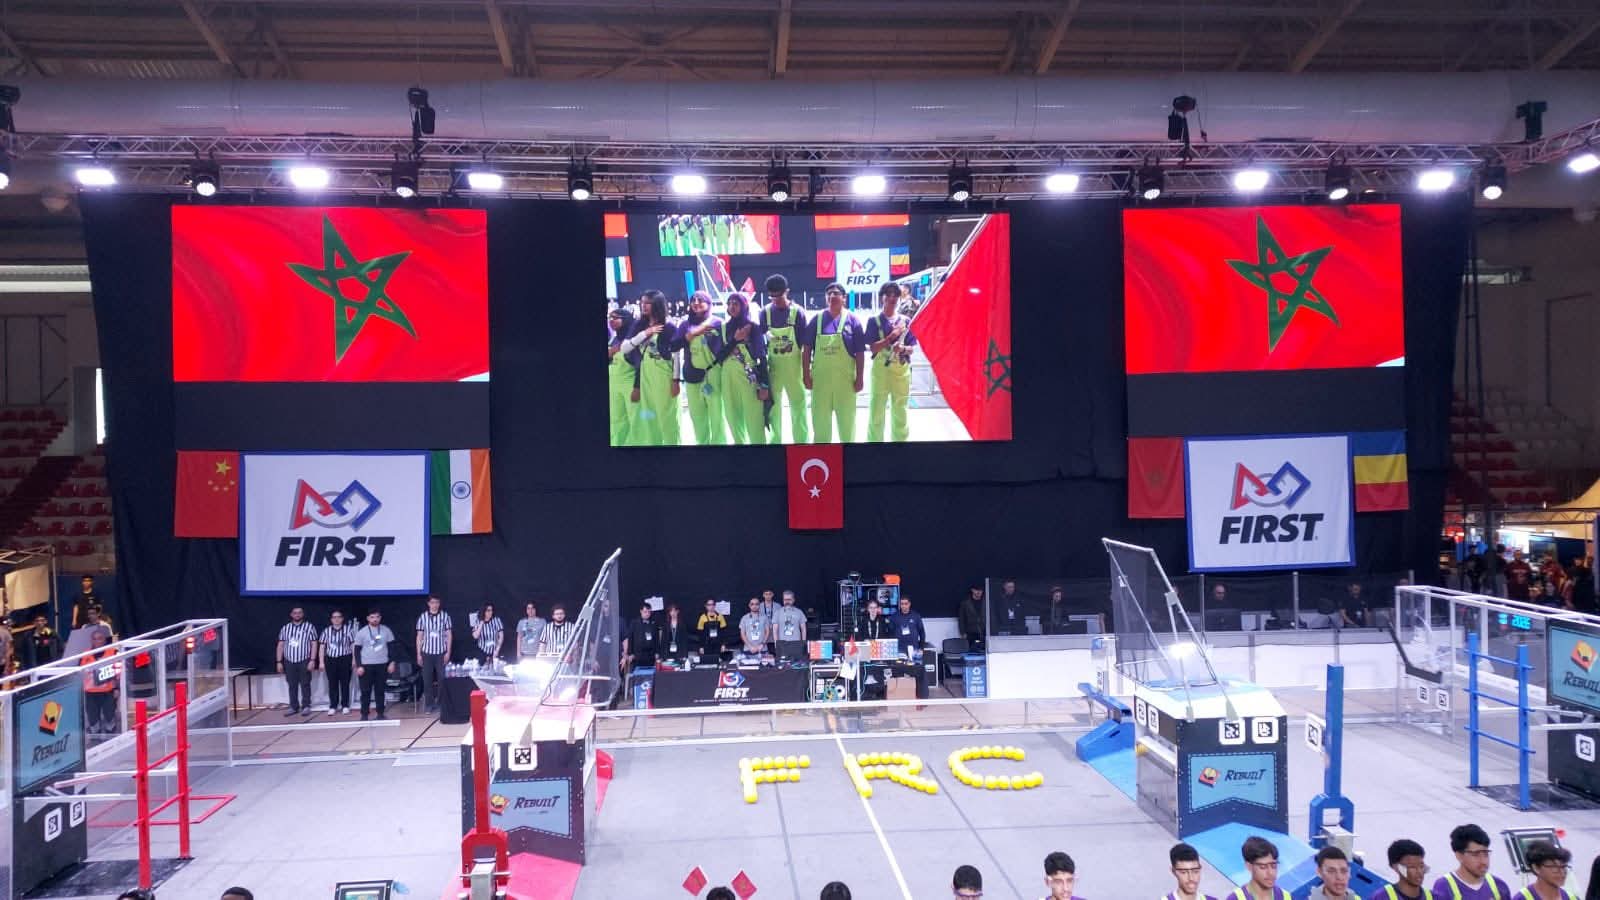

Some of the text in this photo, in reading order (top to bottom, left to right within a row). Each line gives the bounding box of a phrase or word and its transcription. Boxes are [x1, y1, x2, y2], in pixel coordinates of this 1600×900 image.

[846, 275, 880, 285] FIRST
[1219, 513, 1324, 545] FIRST
[275, 536, 395, 567] FIRST
[1562, 671, 1600, 694] REBUIL
[714, 688, 750, 698] FIRST
[1224, 768, 1266, 781] REBUILT
[513, 795, 560, 810] REBUILT
